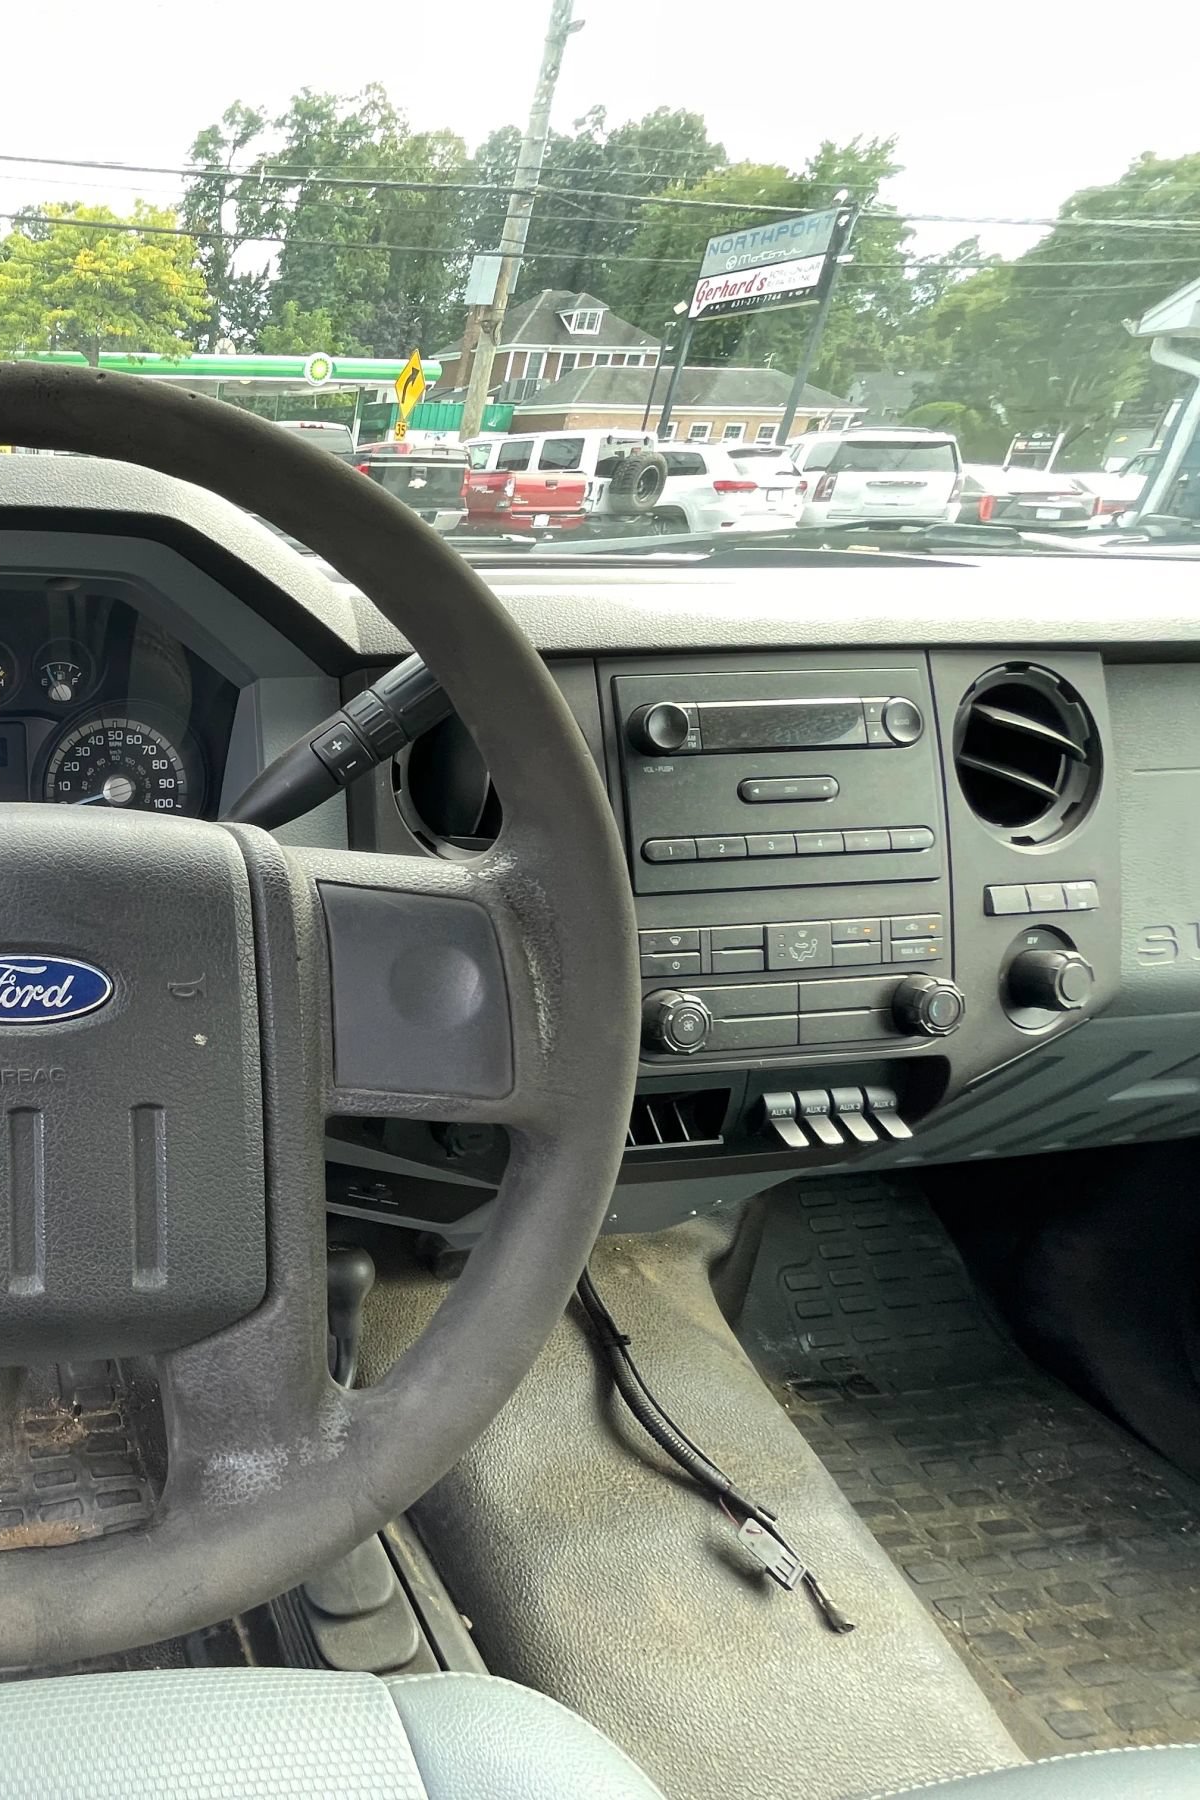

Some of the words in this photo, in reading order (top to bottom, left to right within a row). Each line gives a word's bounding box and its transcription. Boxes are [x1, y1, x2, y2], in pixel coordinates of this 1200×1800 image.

[707, 214, 833, 257] NORTHPORT
[696, 272, 767, 310] Gerhard's
[88, 735, 104, 745] 40
[108, 730, 123, 740] 50
[126, 734, 142, 745] 60
[75, 746, 91, 757] 30
[142, 745, 157, 755] 70
[63, 761, 80, 772] 20
[152, 759, 168, 770] 80
[59, 781, 71, 791] 10
[159, 778, 175, 789] 90
[154, 798, 174, 809] 100
[719, 843, 725, 853] 2
[768, 841, 775, 850] 3
[806, 1106, 821, 1114] AUX
[839, 1103, 855, 1111] AUX
